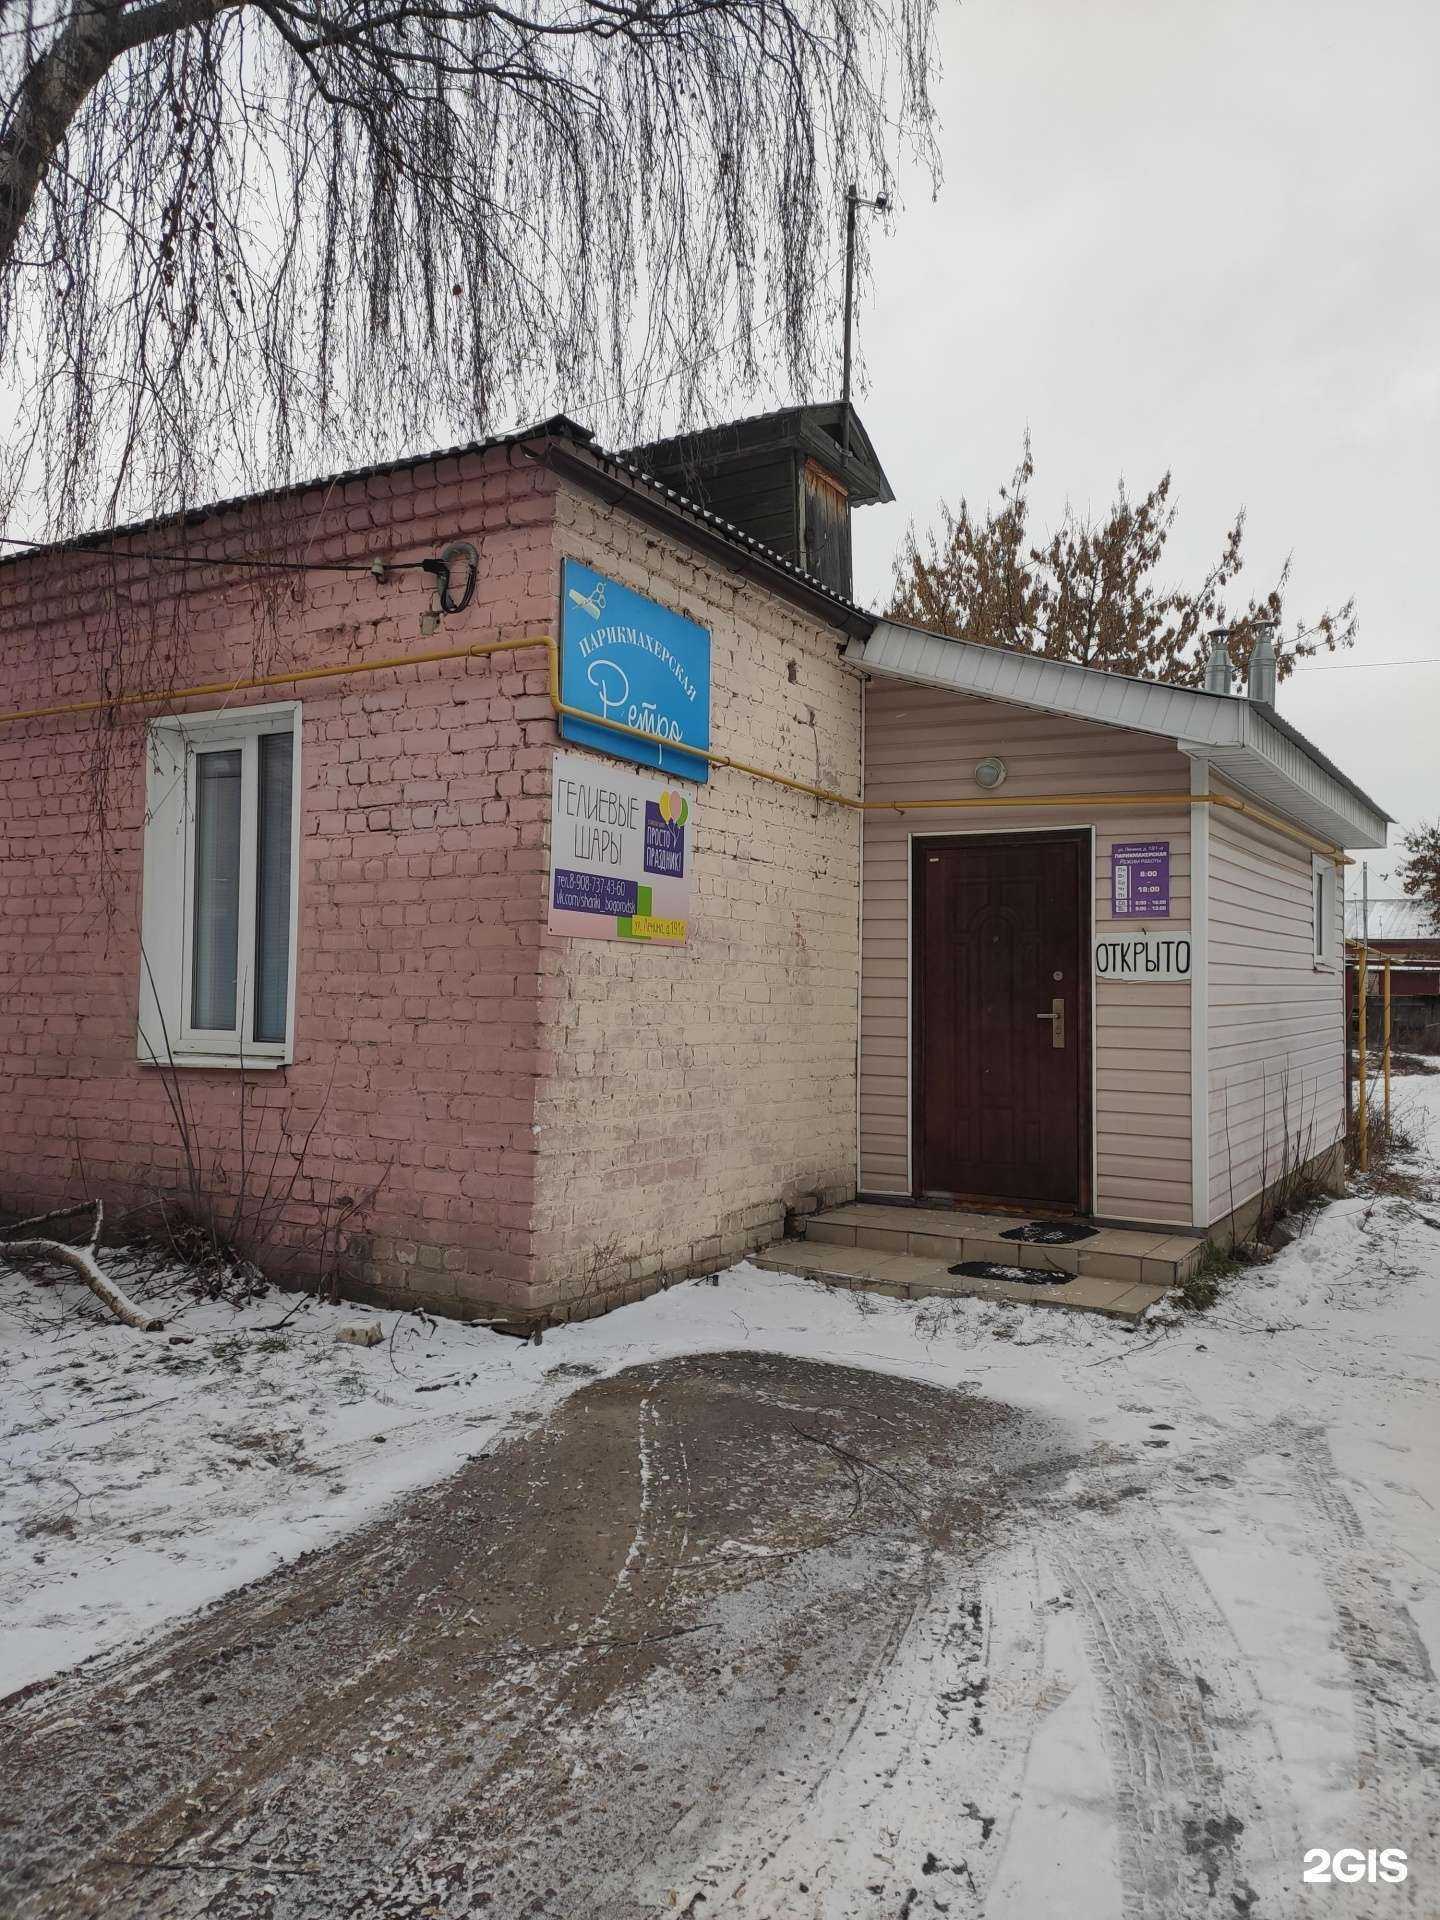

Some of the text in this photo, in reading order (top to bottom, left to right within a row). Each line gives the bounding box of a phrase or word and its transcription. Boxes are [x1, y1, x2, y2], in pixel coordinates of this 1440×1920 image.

[578, 624, 697, 702] ПАРИКМАХЕРСКАЯ
[587, 659, 684, 766] Ретро
[557, 779, 640, 830] ГЕЛИЕВЫЕ
[574, 823, 623, 866] ШАРЫ
[646, 826, 671, 848] ПРОСТО
[1096, 941, 1191, 974] ОТКРЫТО
